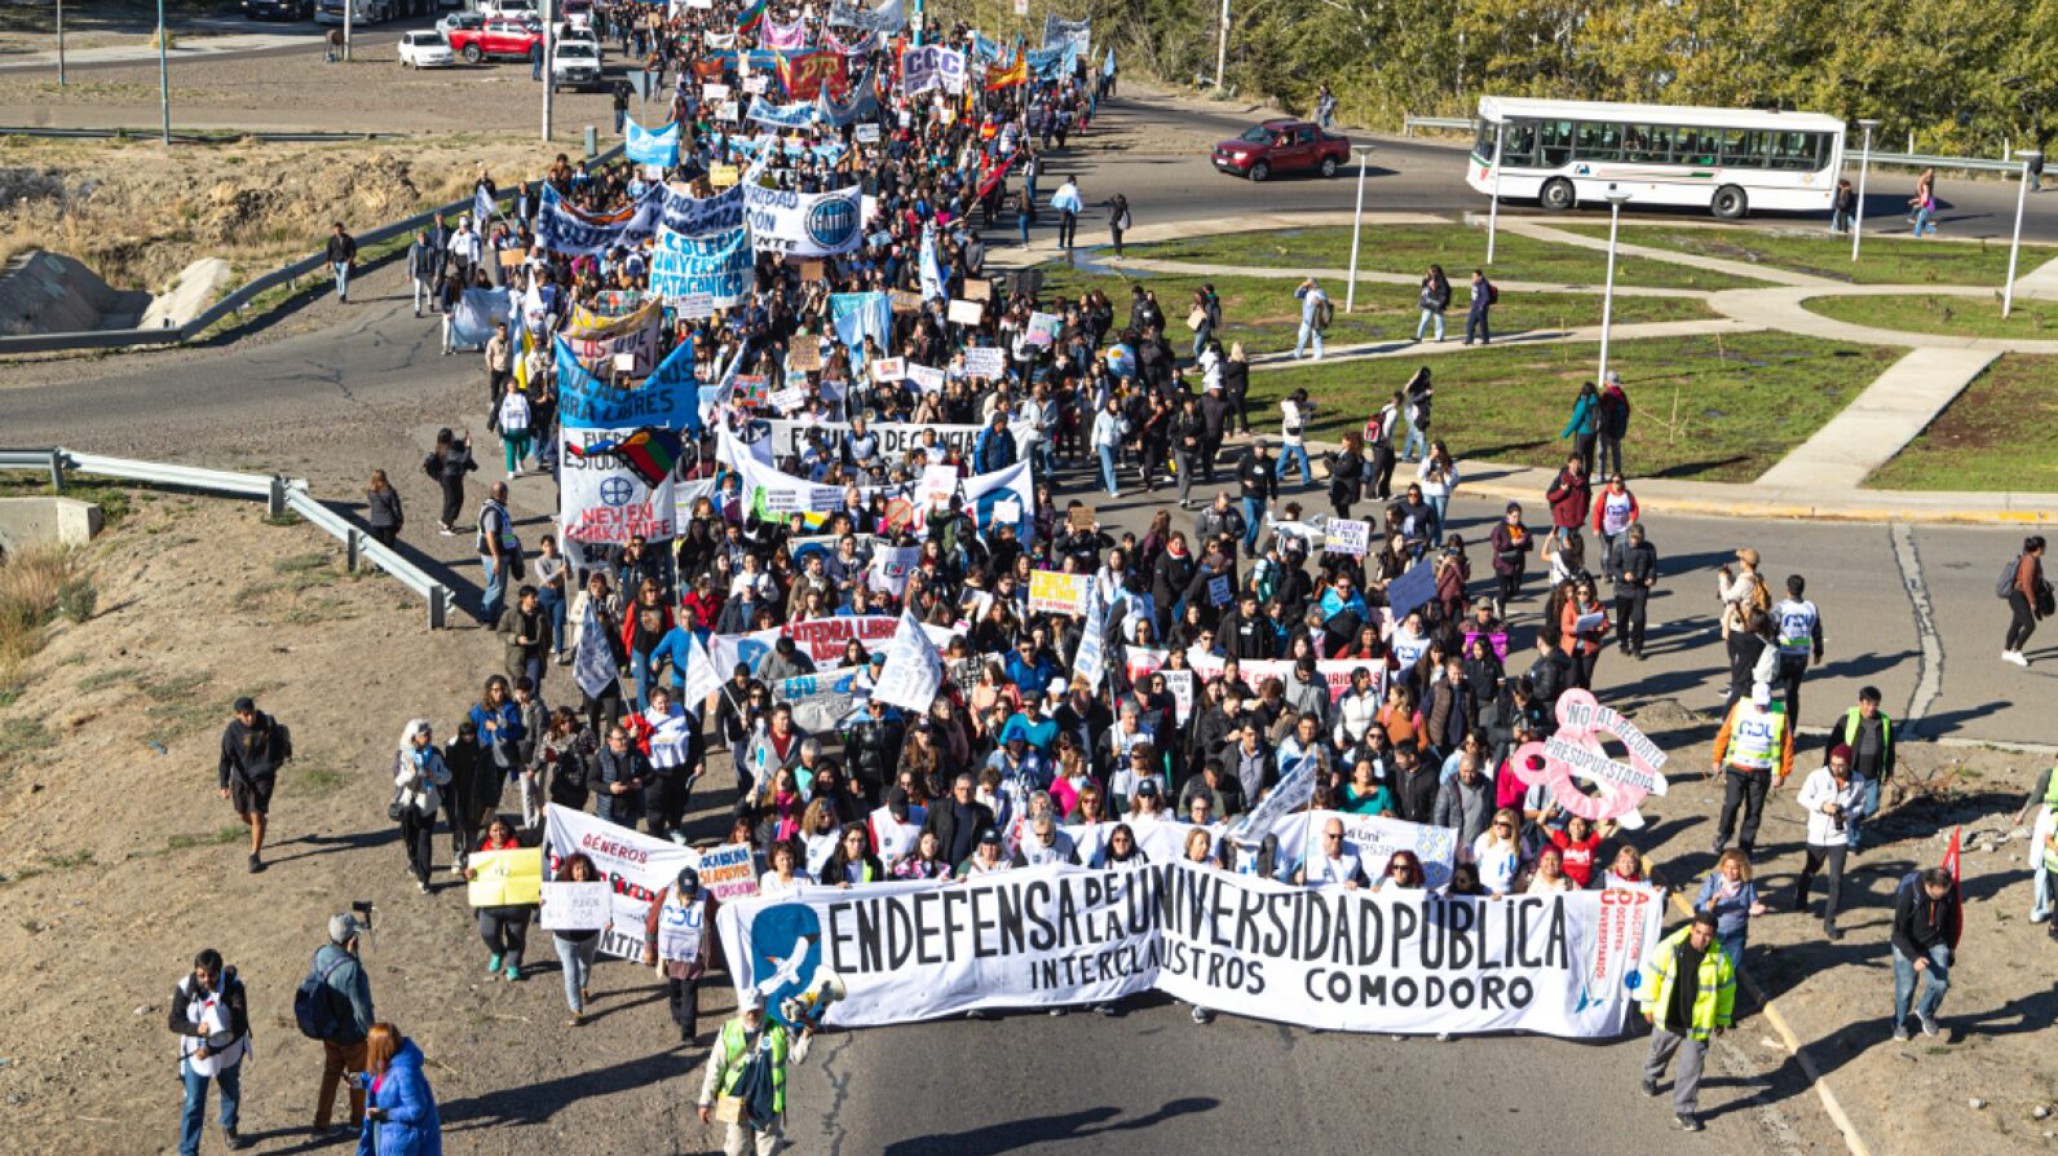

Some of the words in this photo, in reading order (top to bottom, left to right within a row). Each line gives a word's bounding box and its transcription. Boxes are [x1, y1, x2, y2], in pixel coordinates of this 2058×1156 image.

[907, 47, 960, 74] CCC
[1085, 872, 1119, 909] DE
[1086, 911, 1124, 943] LA
[1125, 863, 1384, 966] UNIVERSIDAD
[1305, 967, 1534, 1010] COMODORO
